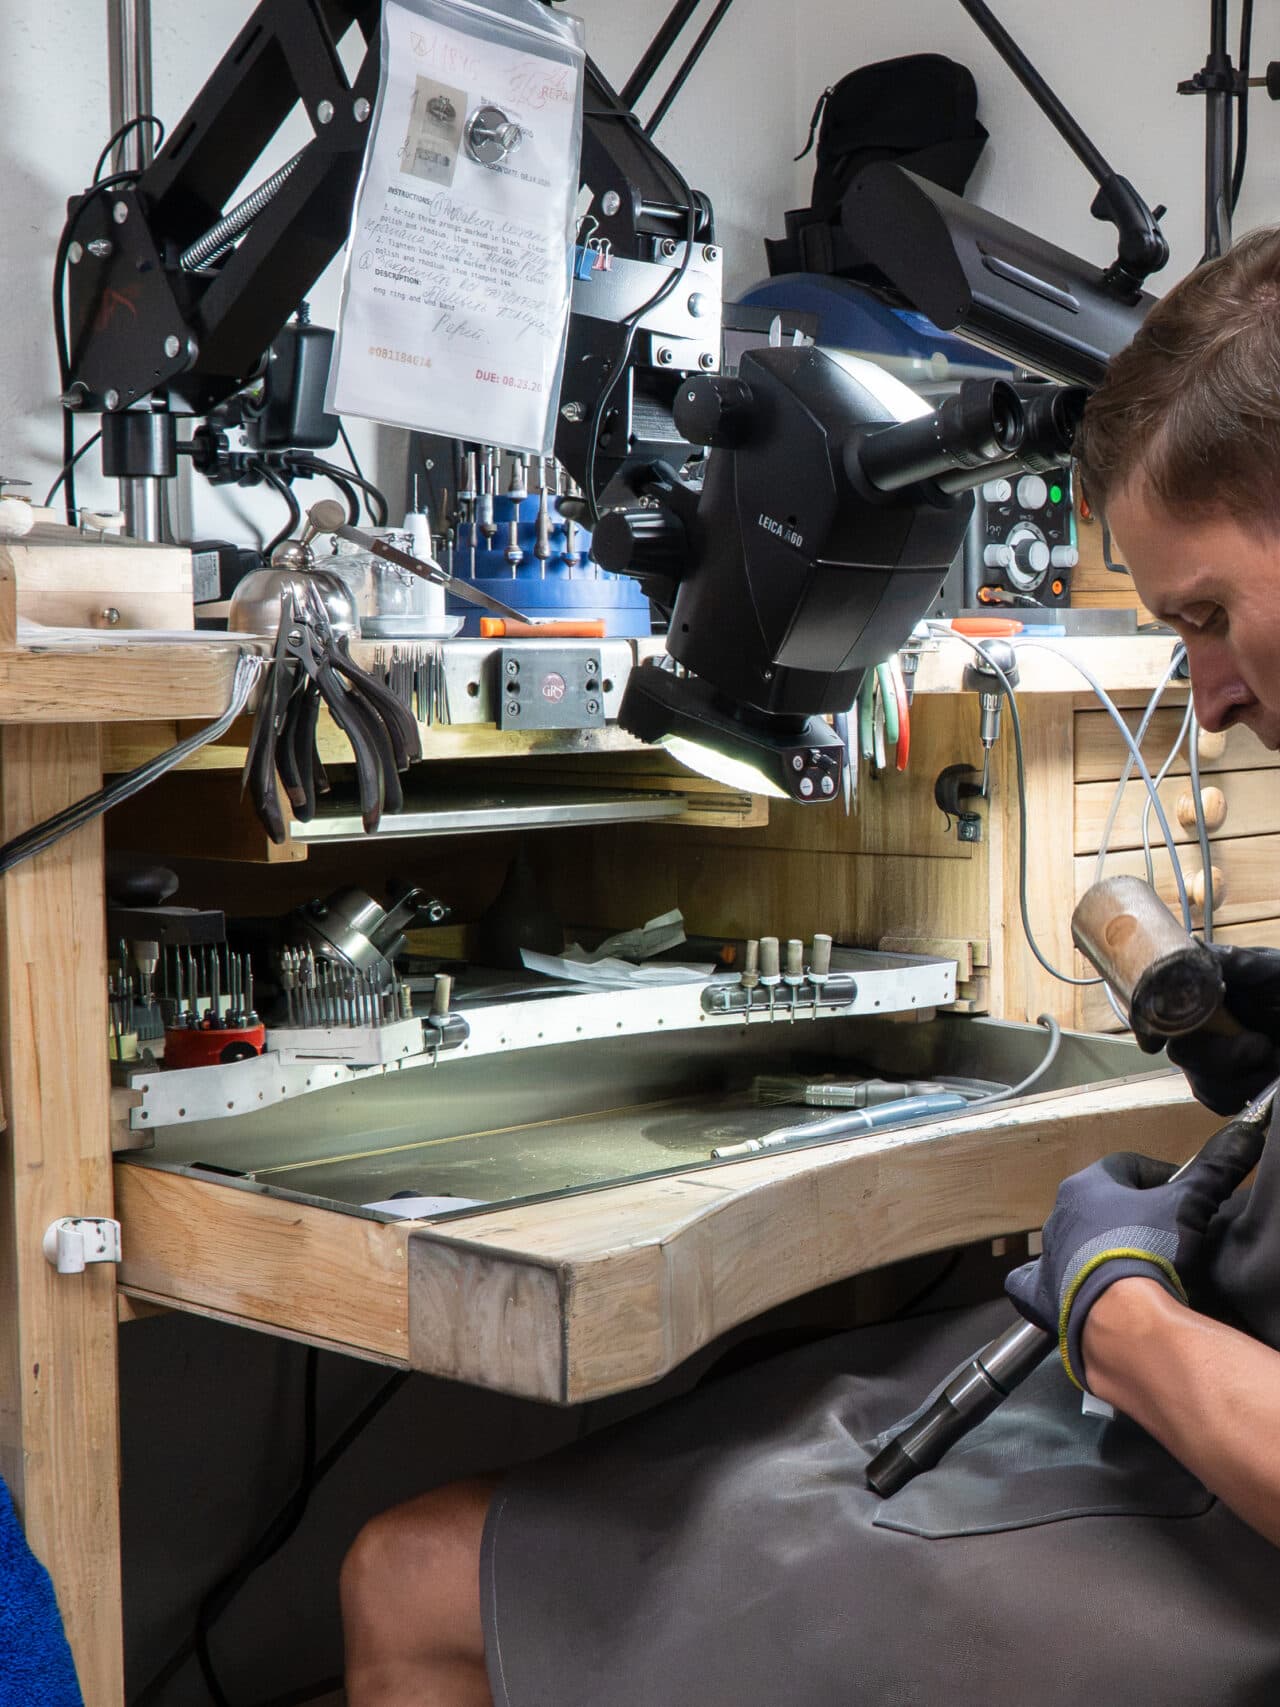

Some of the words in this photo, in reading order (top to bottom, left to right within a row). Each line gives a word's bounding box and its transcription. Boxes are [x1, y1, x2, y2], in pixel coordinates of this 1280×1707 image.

[380, 215, 403, 227] polish
[405, 222, 417, 230] and
[465, 228, 488, 240] marked
[375, 248, 400, 260] polish
[403, 255, 415, 263] and
[388, 238, 416, 252] Tighten
[464, 260, 487, 271] marked
[373, 286, 386, 296] eng
[390, 289, 406, 301] ring
[408, 295, 421, 303] and
[475, 369, 499, 384] DUE:
[758, 513, 783, 537] LEICA
[543, 685, 563, 699] GRS
